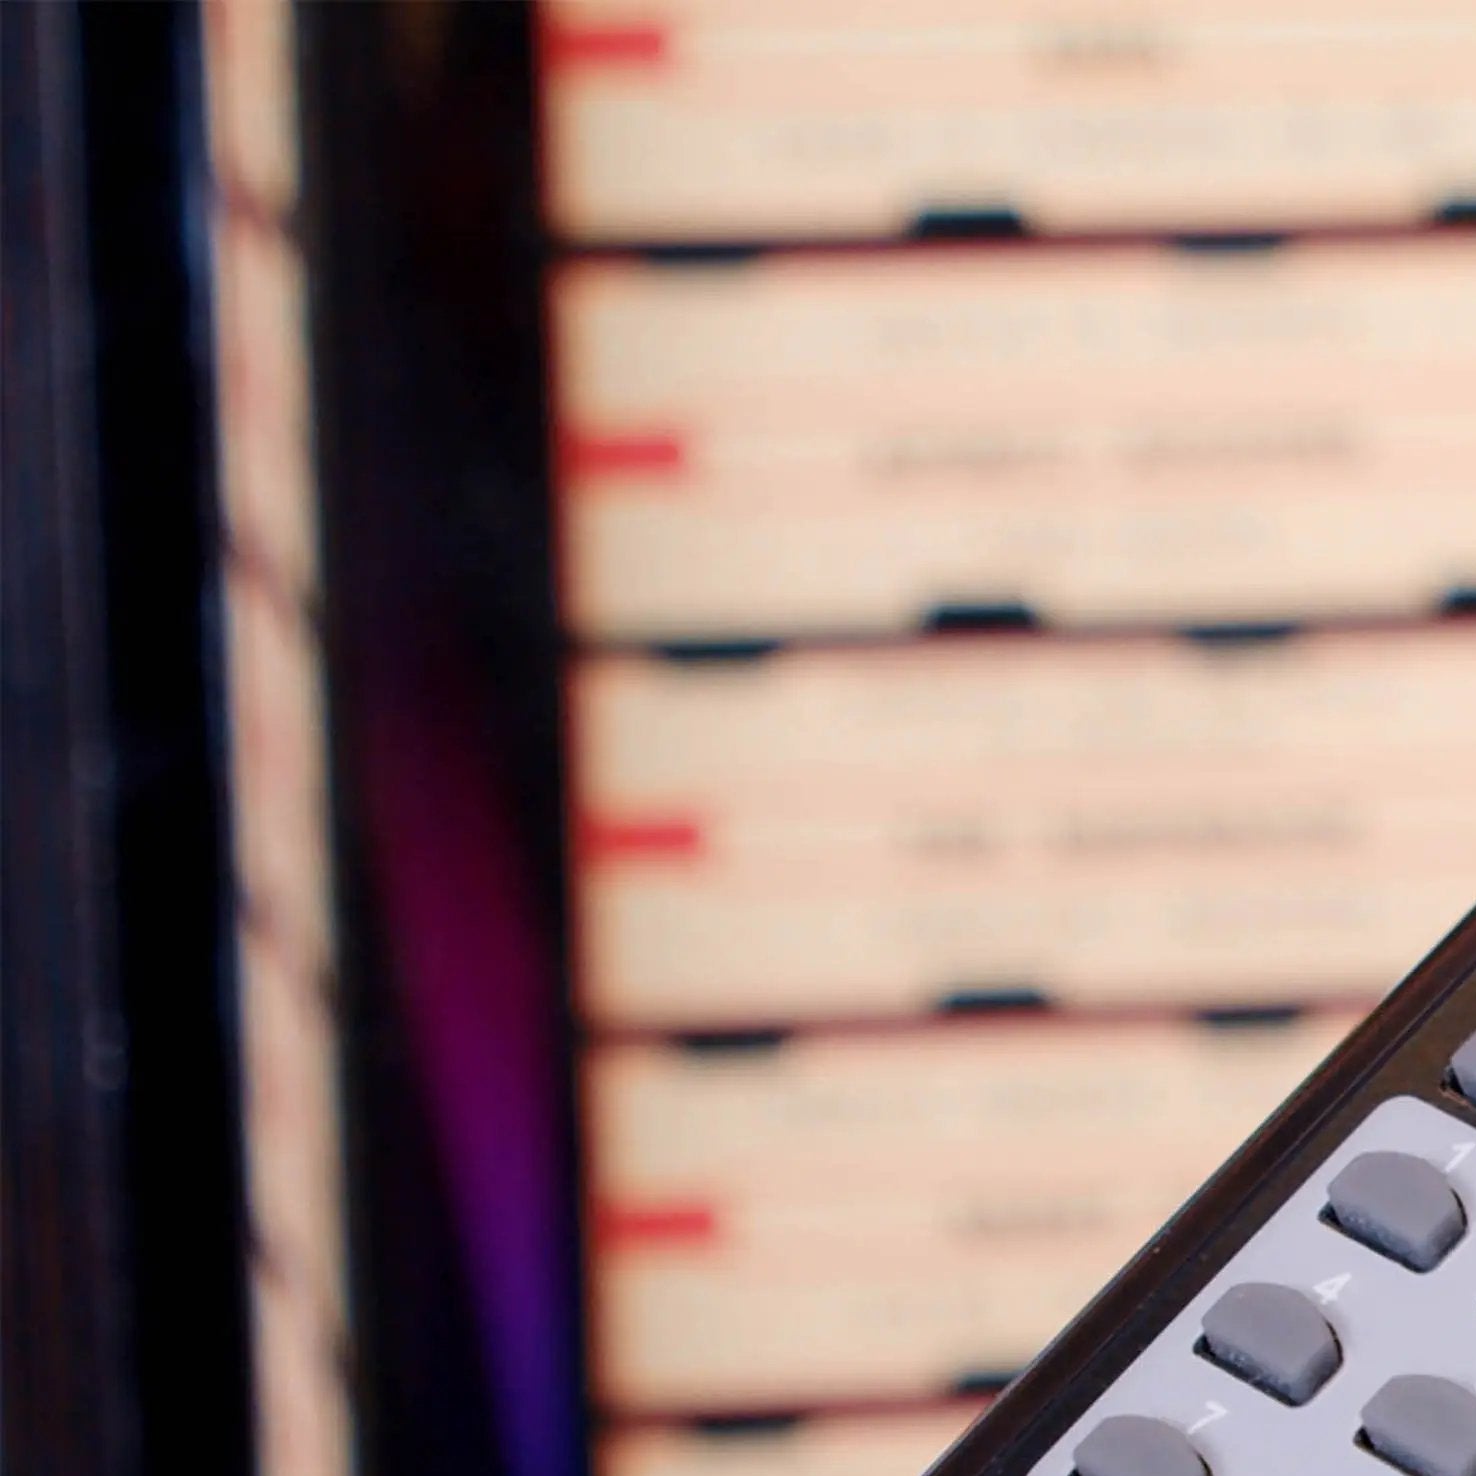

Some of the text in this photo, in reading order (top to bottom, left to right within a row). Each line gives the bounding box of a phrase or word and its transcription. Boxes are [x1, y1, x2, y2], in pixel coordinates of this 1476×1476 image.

[1442, 1141, 1476, 1174] 1
[1312, 1271, 1352, 1305] 4
[1187, 1402, 1228, 1434] 7
